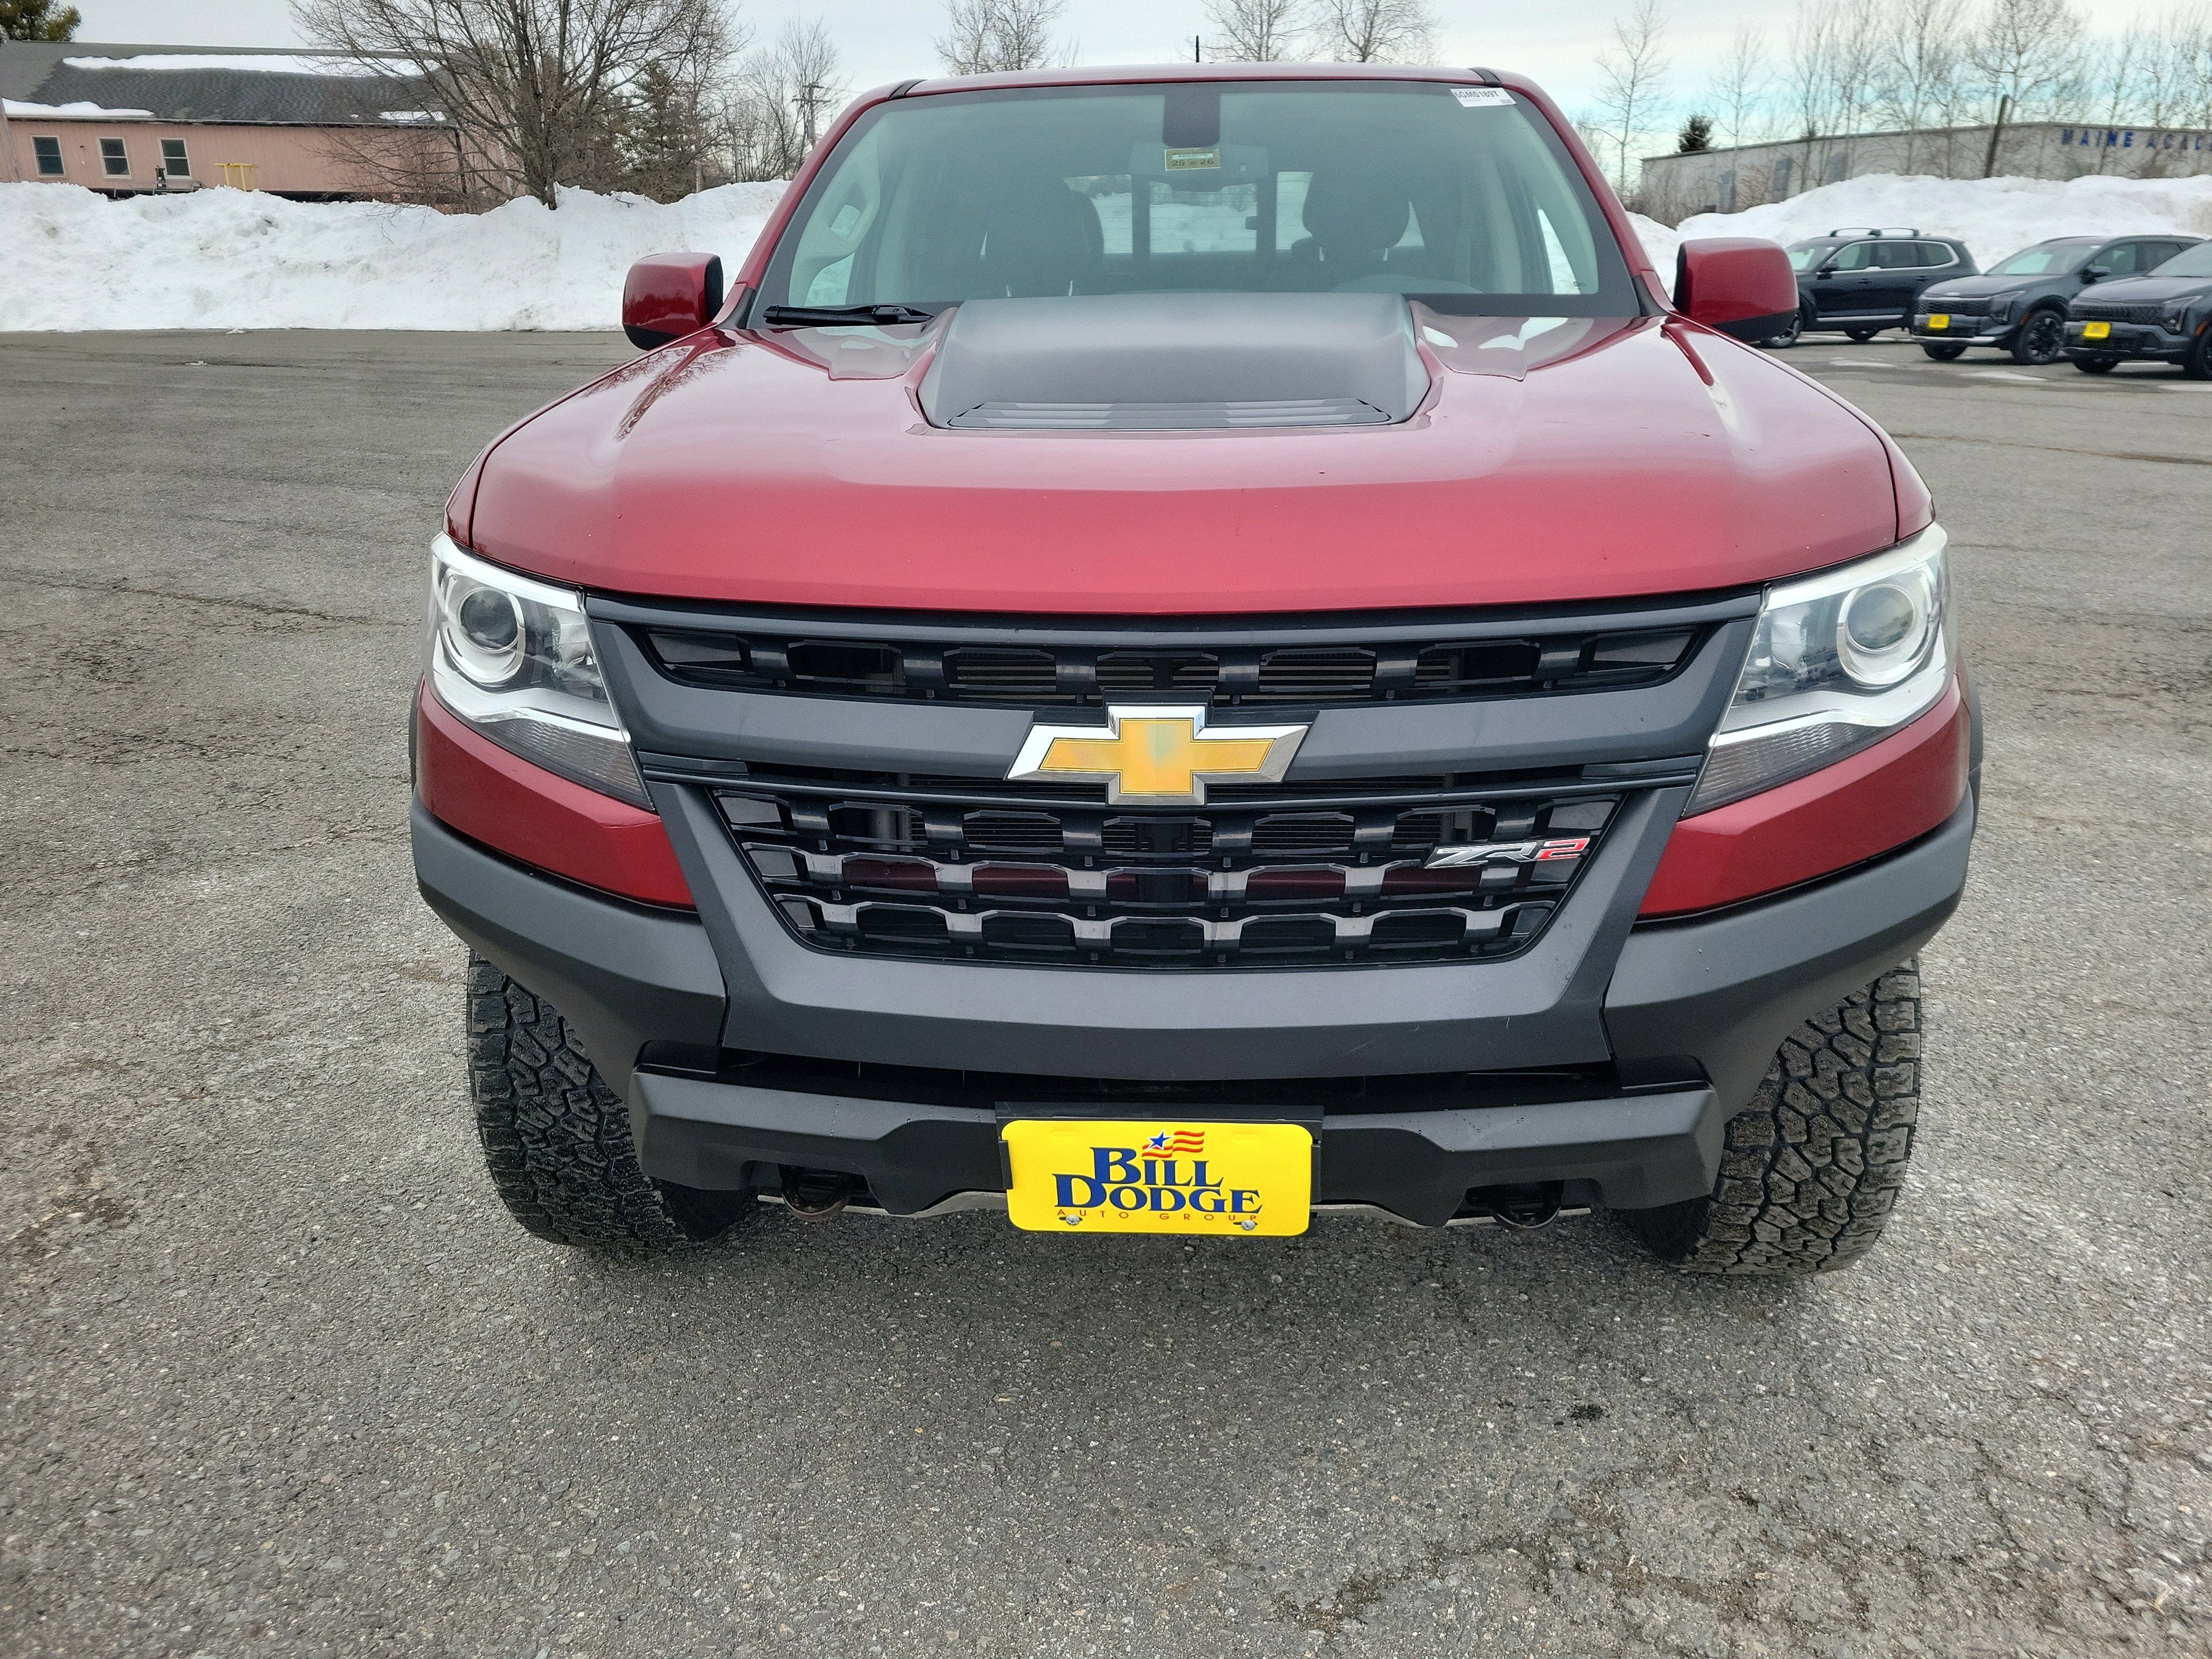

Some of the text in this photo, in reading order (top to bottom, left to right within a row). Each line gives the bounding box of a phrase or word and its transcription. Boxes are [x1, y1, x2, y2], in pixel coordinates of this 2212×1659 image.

[2062, 129, 2133, 148] MAINE
[1424, 837, 1590, 868] ZR2
[1089, 1147, 1224, 1187] BILL
[1051, 1173, 1263, 1214] DODGE
[1057, 1209, 1257, 1222] AUTO GROUP
